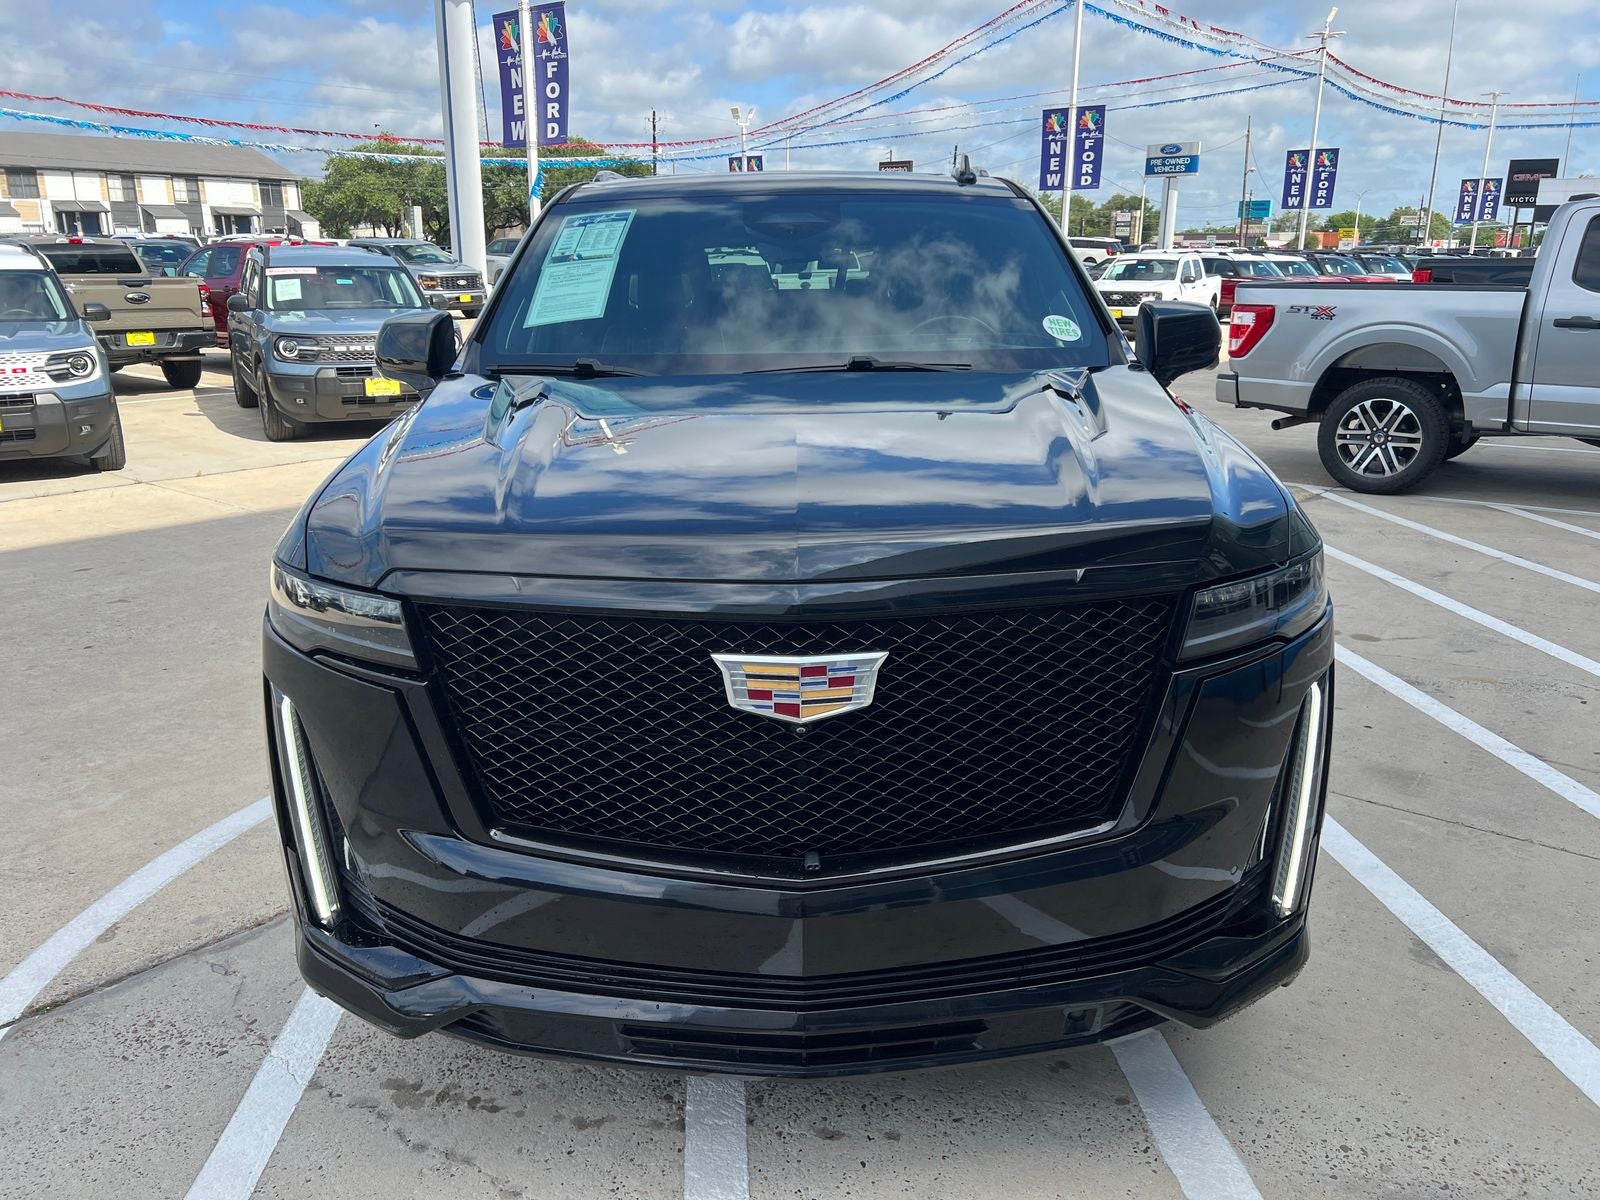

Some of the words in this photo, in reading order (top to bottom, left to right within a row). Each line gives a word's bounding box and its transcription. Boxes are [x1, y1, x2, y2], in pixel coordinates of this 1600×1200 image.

[510, 67, 526, 141] NEW
[545, 61, 560, 138] FORD
[1046, 141, 1061, 187] NEW
[1080, 139, 1095, 186] FORD
[1153, 164, 1186, 173] VEHICLES
[1287, 173, 1301, 207] NEW
[1315, 172, 1330, 206] FORD
[1461, 195, 1473, 220] NEW
[1483, 195, 1495, 220] FORD
[1047, 317, 1072, 328] NEW
[1286, 305, 1337, 317] STX
[1047, 326, 1079, 338] TIRES
